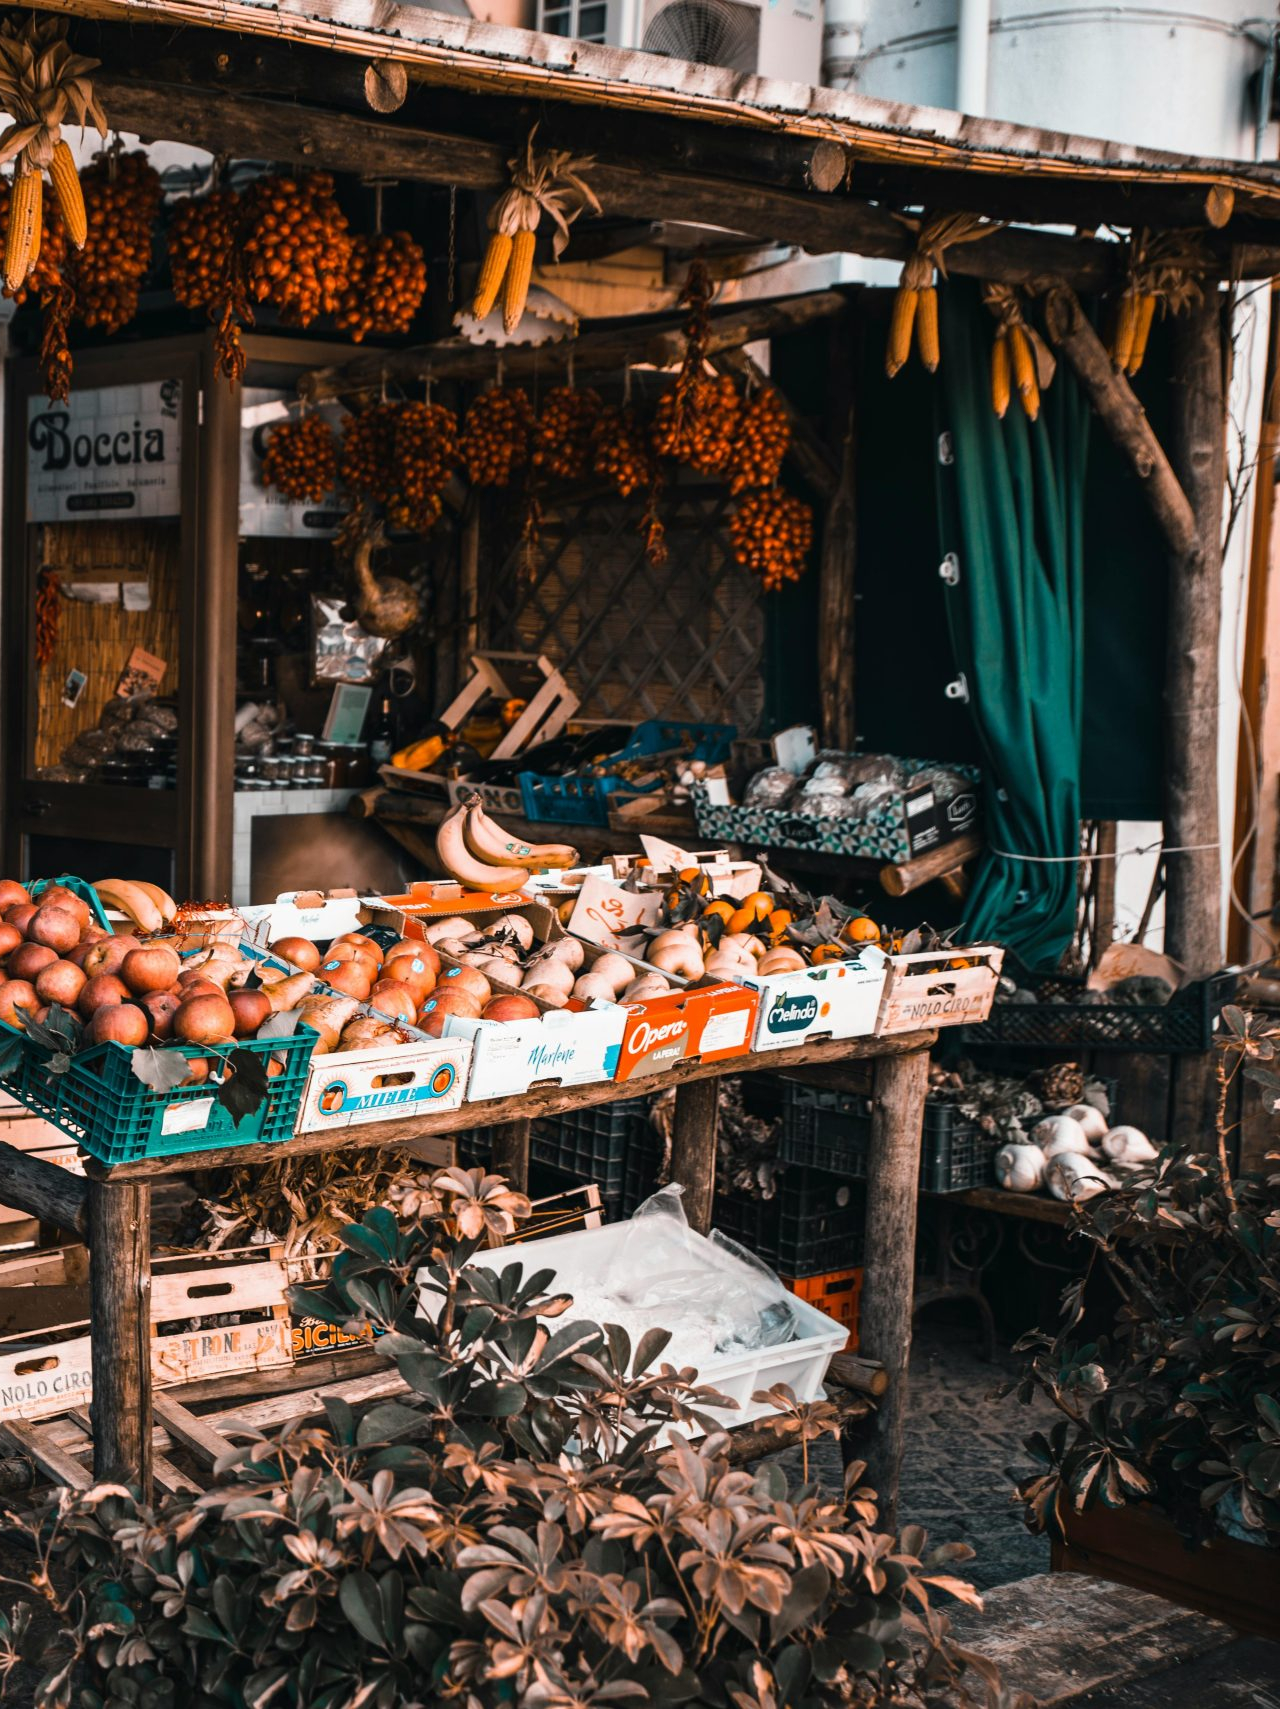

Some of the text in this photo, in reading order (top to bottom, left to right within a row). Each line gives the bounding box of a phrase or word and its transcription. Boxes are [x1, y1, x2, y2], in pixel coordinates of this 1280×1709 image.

[29, 412, 165, 471] Boccia
[769, 1003, 816, 1024] Melinda
[910, 1000, 941, 1020] NOLO
[942, 998, 971, 1013] CIRO
[627, 1020, 683, 1054] Opera
[527, 1043, 576, 1075] Marlene
[355, 1088, 419, 1109] MIELE
[1, 1380, 48, 1407] NOLO
[53, 1370, 92, 1392] CIRO
